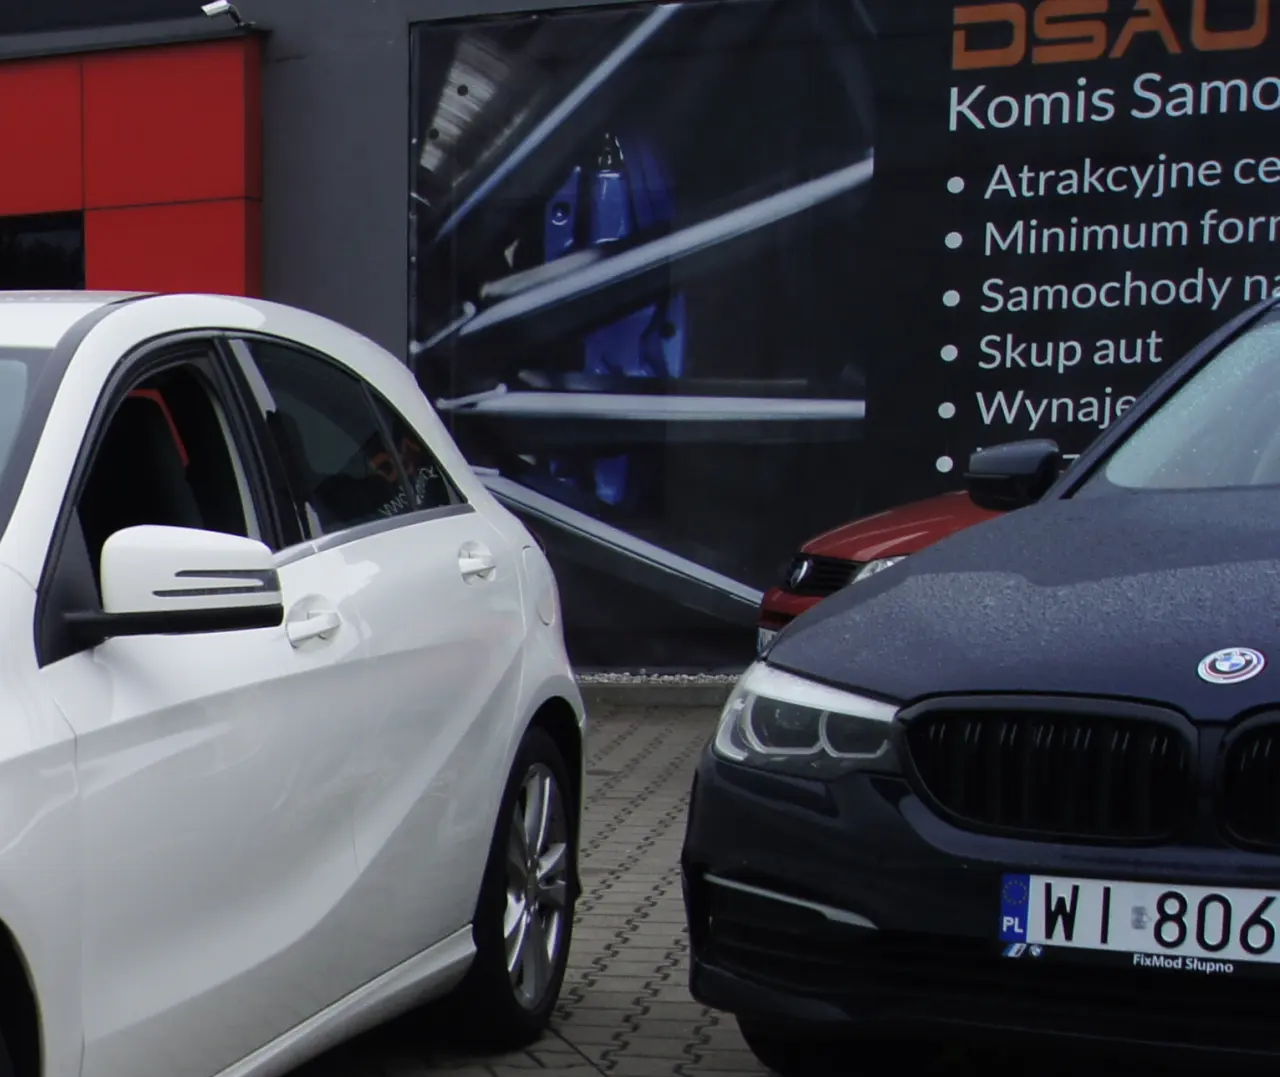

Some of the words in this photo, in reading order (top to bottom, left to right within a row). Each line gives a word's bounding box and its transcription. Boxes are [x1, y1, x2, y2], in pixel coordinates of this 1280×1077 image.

[949, 77, 1115, 131] Komis
[1131, 73, 1280, 119] Samo
[984, 153, 1222, 200] Atrakcyjne
[1234, 156, 1280, 185] ce
[984, 217, 1188, 256] Minimum
[980, 268, 1232, 313] Samochody
[1244, 274, 1280, 302] n
[978, 333, 1082, 373] Skup
[1093, 330, 1164, 365] aut
[976, 387, 1138, 431] Wynaje
[1002, 916, 1024, 934] PL
[1044, 882, 1111, 945] WI
[1153, 890, 1278, 955] 806
[1132, 953, 1182, 969] FixMod
[1185, 957, 1234, 975] Słupno
